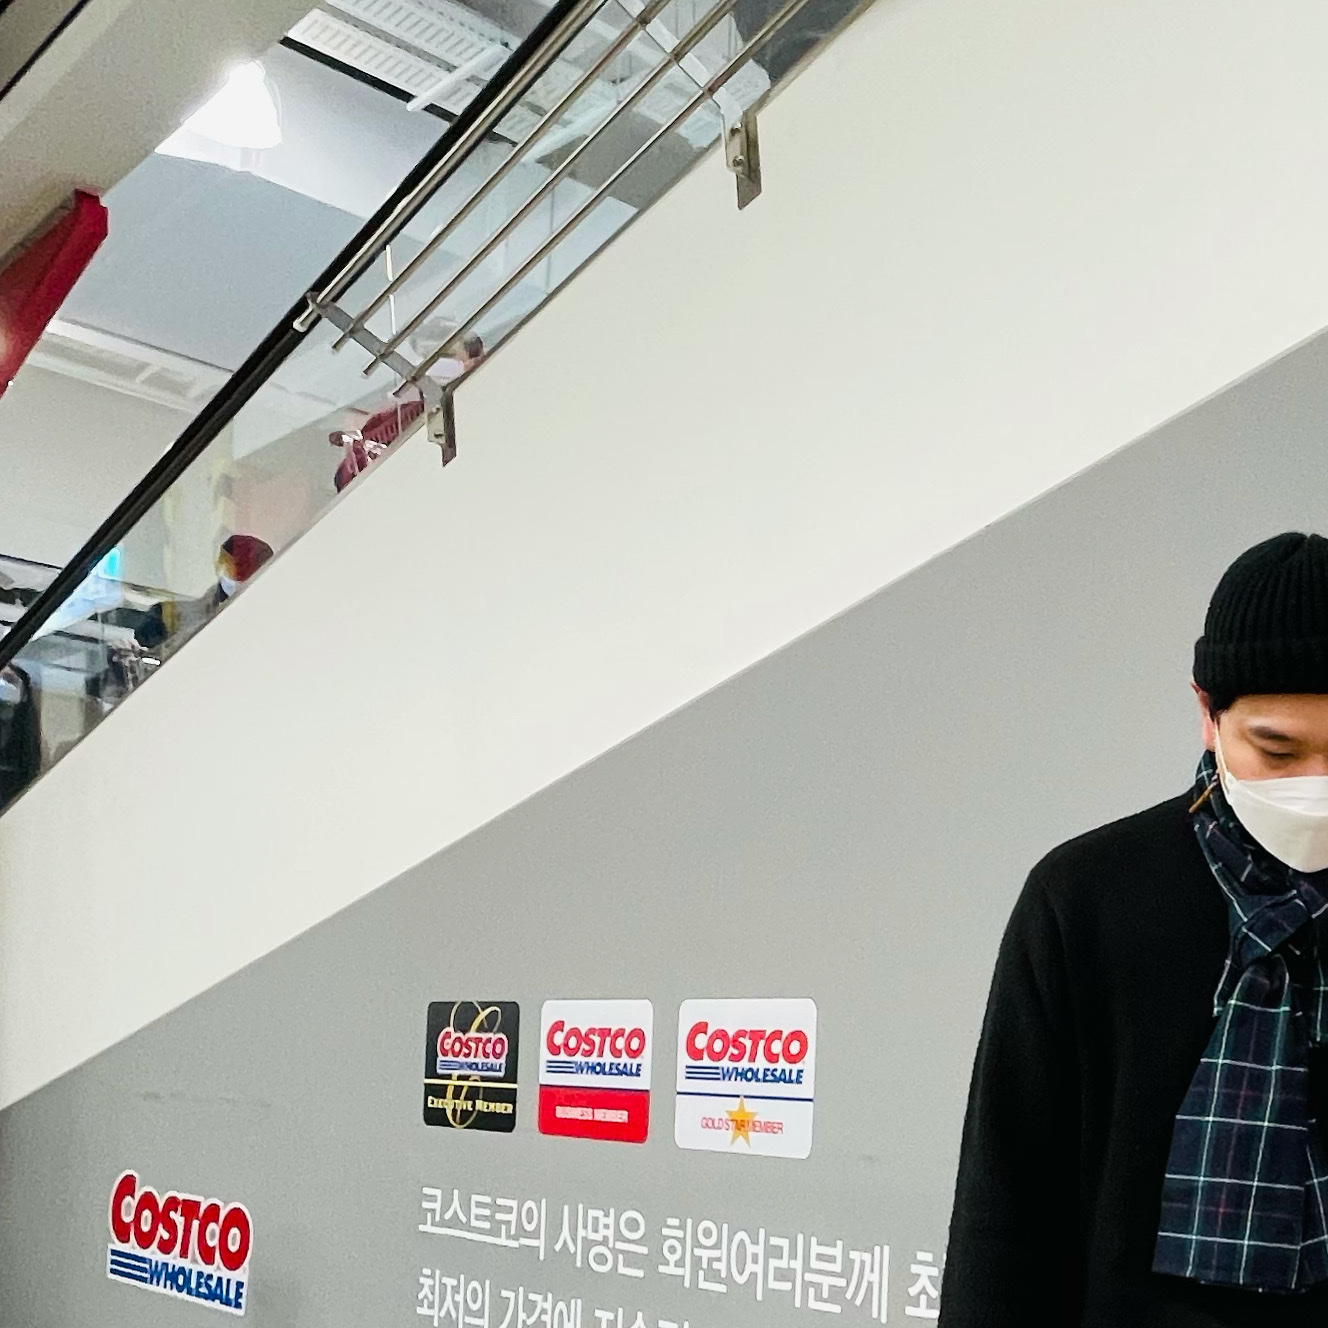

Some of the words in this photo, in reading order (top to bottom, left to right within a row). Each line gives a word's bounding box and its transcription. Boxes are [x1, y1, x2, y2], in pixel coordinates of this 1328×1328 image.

[438, 1030, 507, 1060] COSTCO
[545, 1020, 646, 1059] COSTCO
[686, 1021, 809, 1064] COSTCO
[574, 1061, 643, 1077] WHOLESALE
[720, 1066, 805, 1085] WHOLESALE
[110, 1172, 251, 1272] COSTCO
[419, 1186, 547, 1260] 코스트코의
[554, 1203, 648, 1278] 사명은
[657, 1217, 889, 1324] 회원여러분께
[147, 1257, 245, 1310] WHOLESALE
